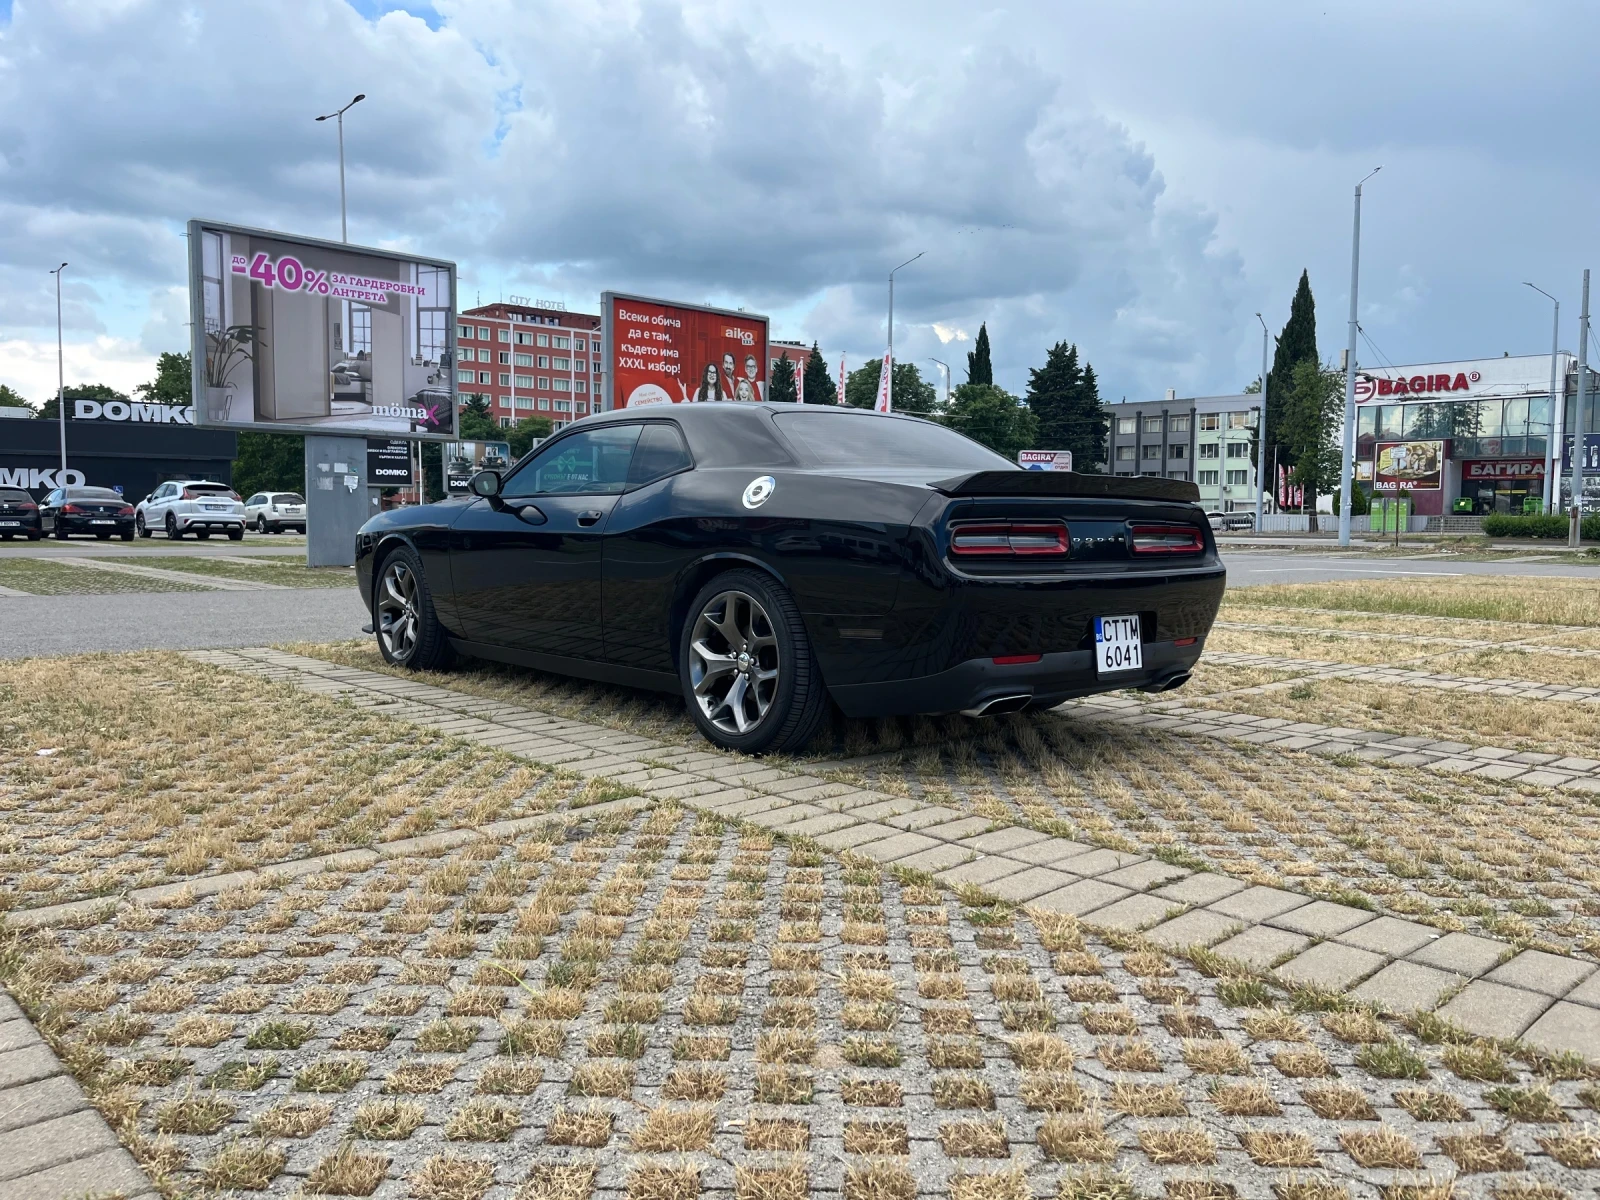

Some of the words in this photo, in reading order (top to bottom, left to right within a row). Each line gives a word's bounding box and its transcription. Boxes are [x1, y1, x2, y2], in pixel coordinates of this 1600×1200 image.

[332, 274, 348, 285] ЗА
[349, 277, 416, 294] ГАРДЕРОБИ
[417, 287, 426, 296] И
[332, 287, 387, 302] АНТРЕТА
[509, 295, 531, 306] CITY
[536, 299, 567, 311] HOTEL
[619, 309, 650, 324] Всеки
[651, 314, 681, 328] обича
[628, 329, 642, 339] да
[651, 332, 672, 343] там,
[725, 327, 754, 340] aiko
[621, 344, 658, 356] където
[659, 349, 679, 358] има
[619, 357, 646, 370] XXXL
[647, 362, 681, 376] избор!
[634, 396, 663, 406] СЕМЕЙСТВО
[1471, 464, 1546, 475] БАГИРА
[1103, 618, 1139, 642] CTTM
[1105, 643, 1139, 668] 6041
